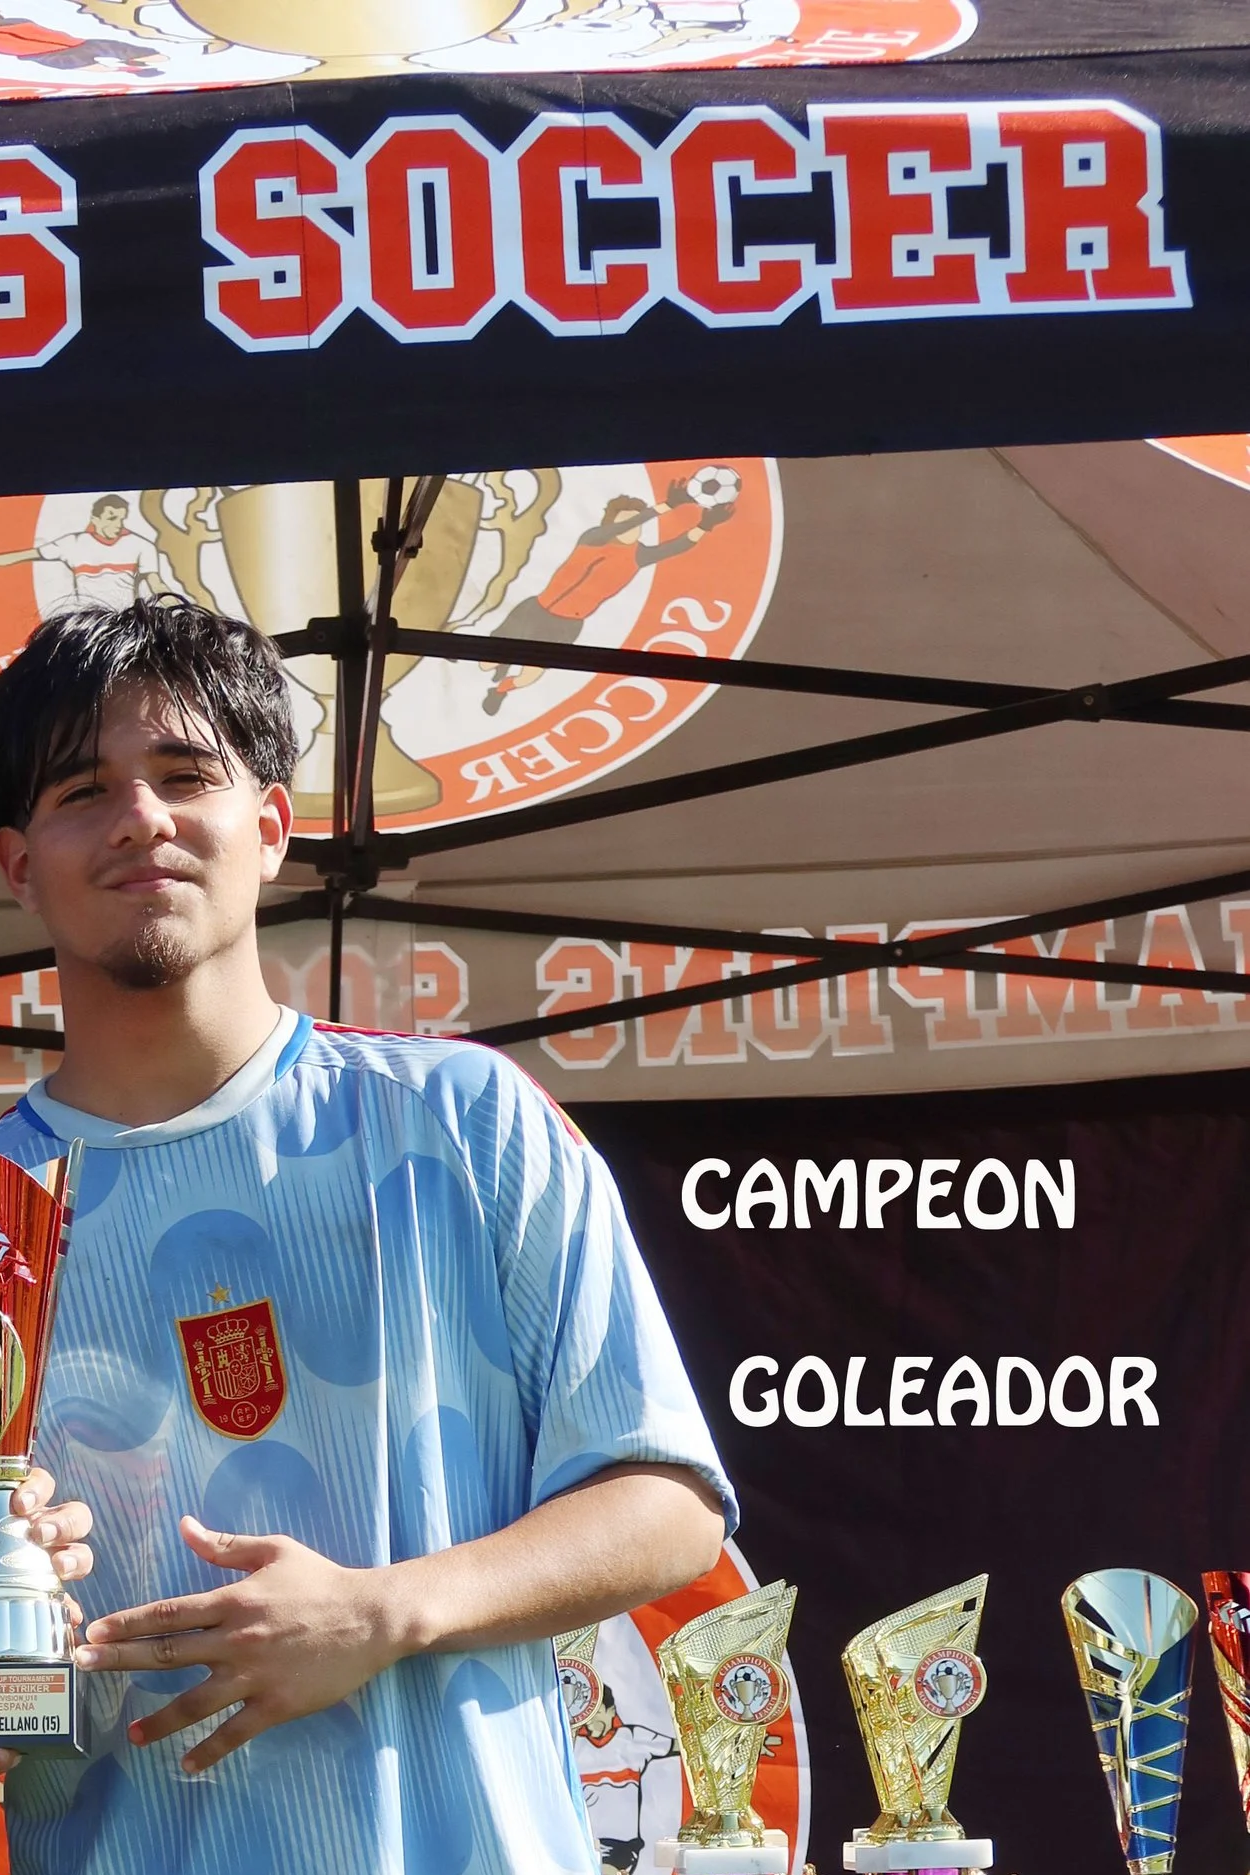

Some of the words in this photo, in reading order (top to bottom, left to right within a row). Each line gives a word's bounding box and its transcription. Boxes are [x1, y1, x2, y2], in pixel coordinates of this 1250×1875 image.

[198, 99, 1193, 353] SOCCER
[719, 1656, 772, 1676] CHAMPIONS
[920, 1650, 974, 1671] CHAMPIONS
[9, 1675, 55, 1683] TOURNAMENT
[9, 1684, 50, 1693] STRIKER
[717, 1696, 740, 1721] SOCCER
[754, 1696, 778, 1720] LEAGUE
[42, 1715, 60, 1732] (15)
